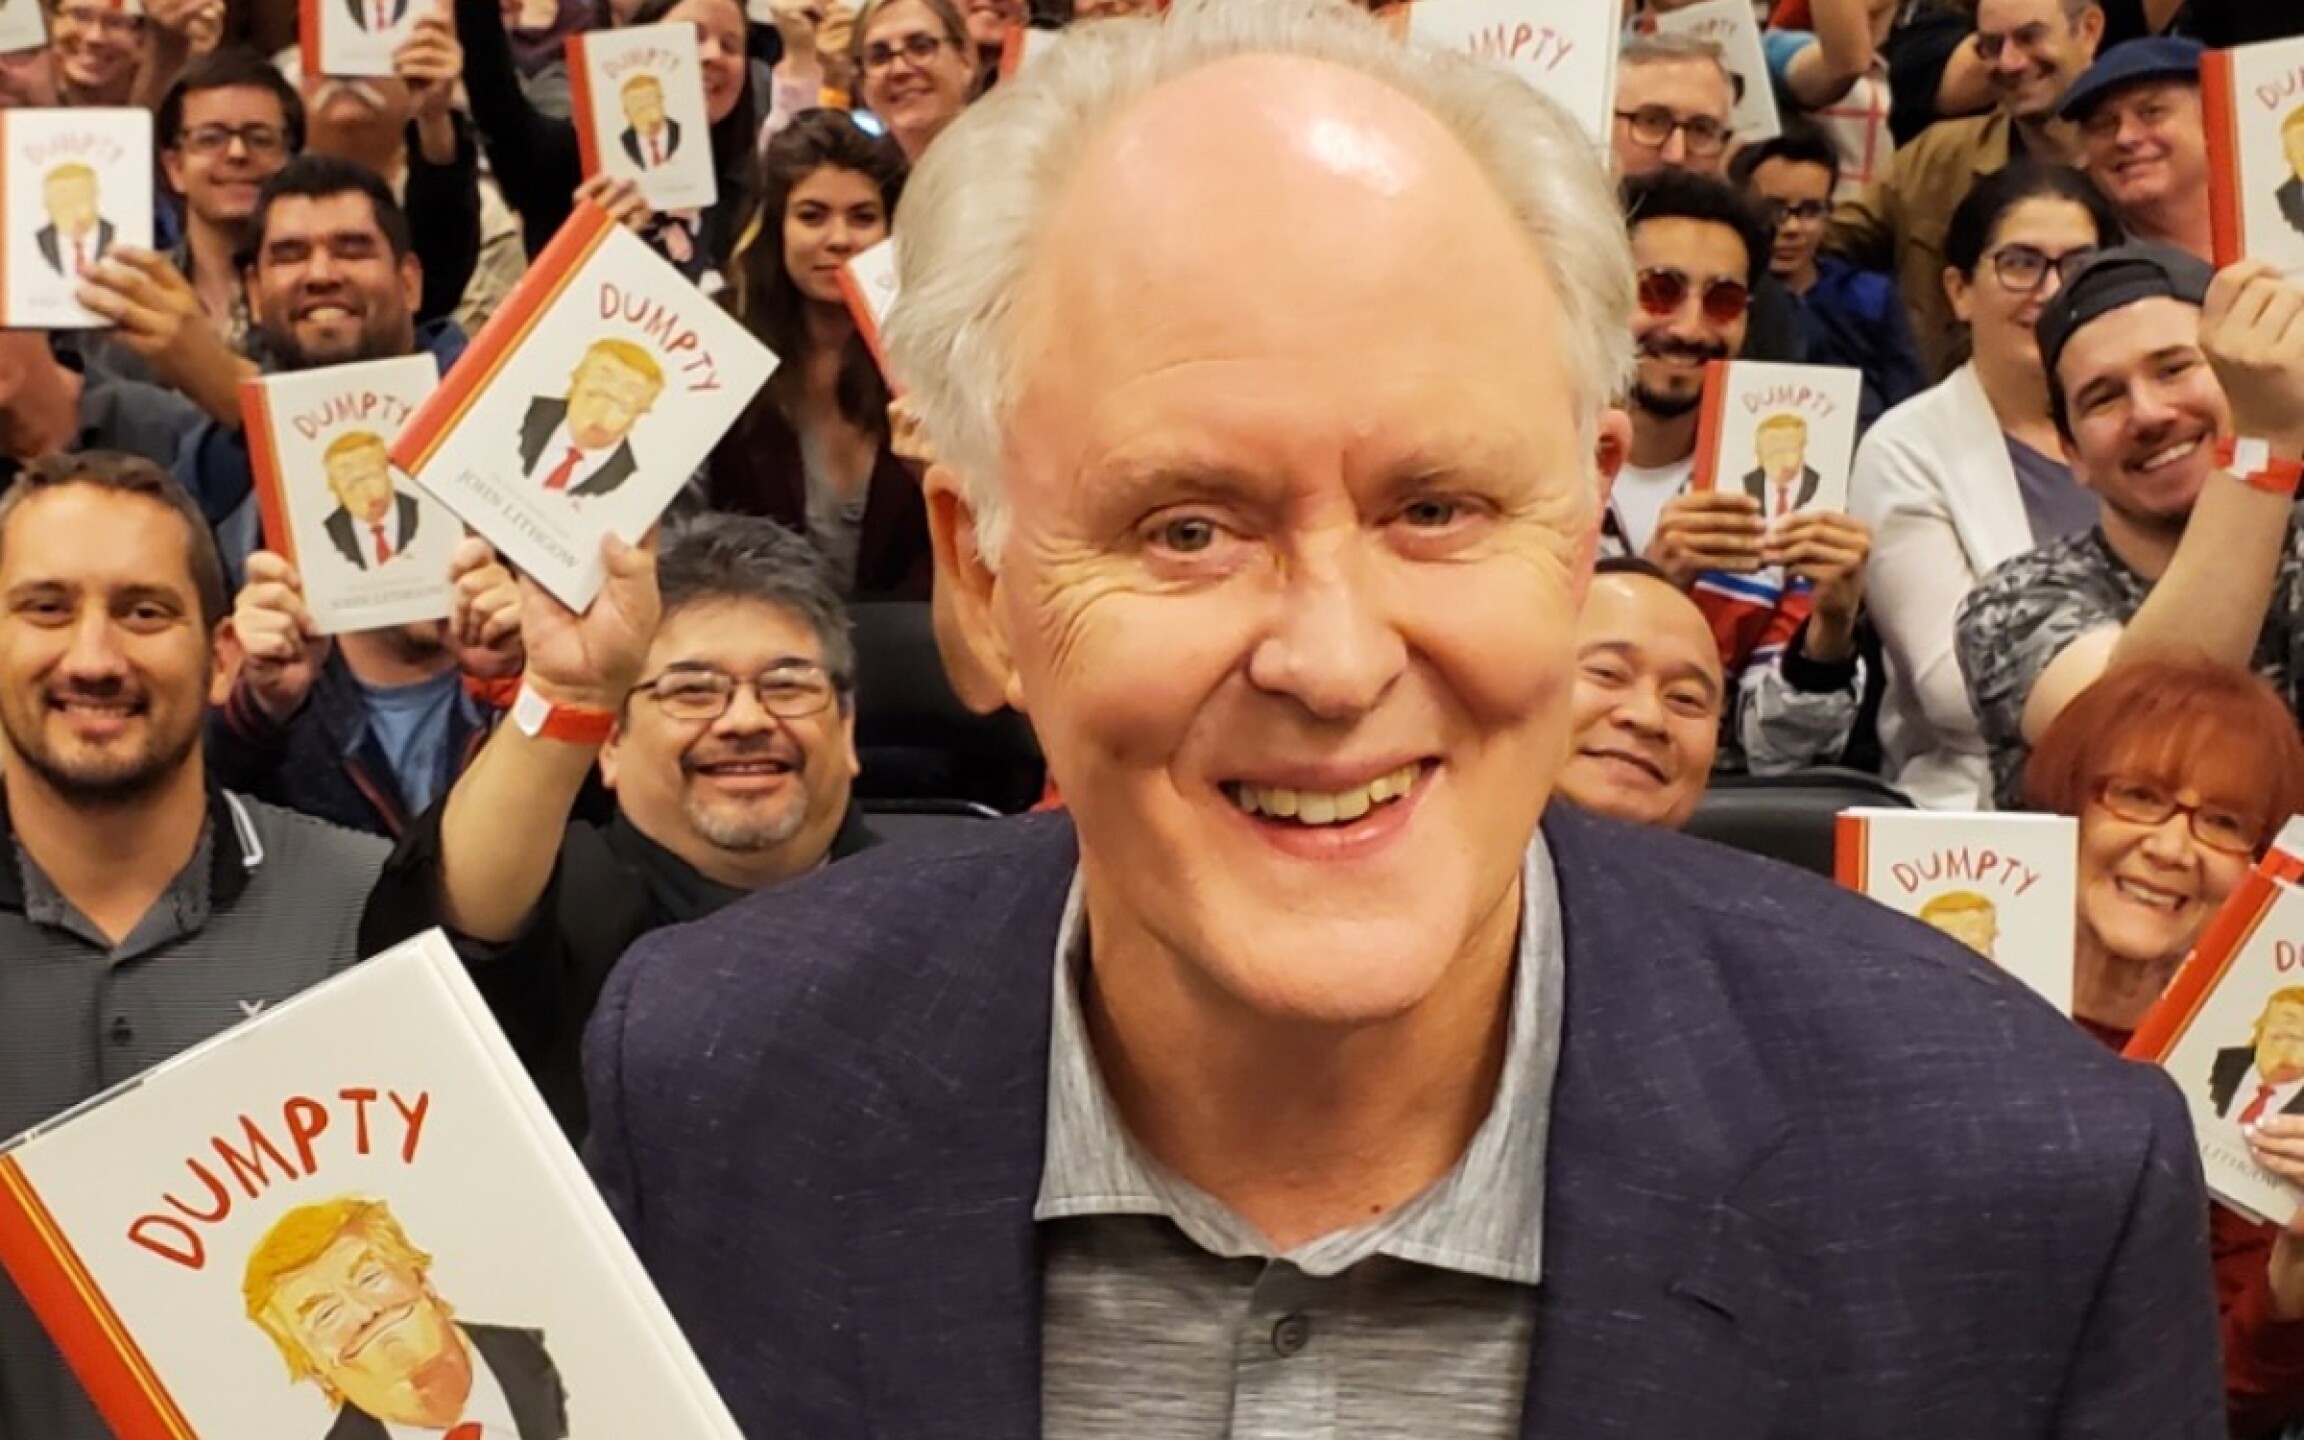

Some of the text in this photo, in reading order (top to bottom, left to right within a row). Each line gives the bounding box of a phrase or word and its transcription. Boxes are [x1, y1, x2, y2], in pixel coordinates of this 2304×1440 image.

[2255, 64, 2304, 110] DU
[599, 282, 721, 392] DUMPTY
[292, 390, 412, 441] DUMPTY
[1742, 383, 1836, 417] DUMPTY
[1890, 846, 2042, 897] DUMPTY
[127, 1087, 430, 1270] DUMPTY
